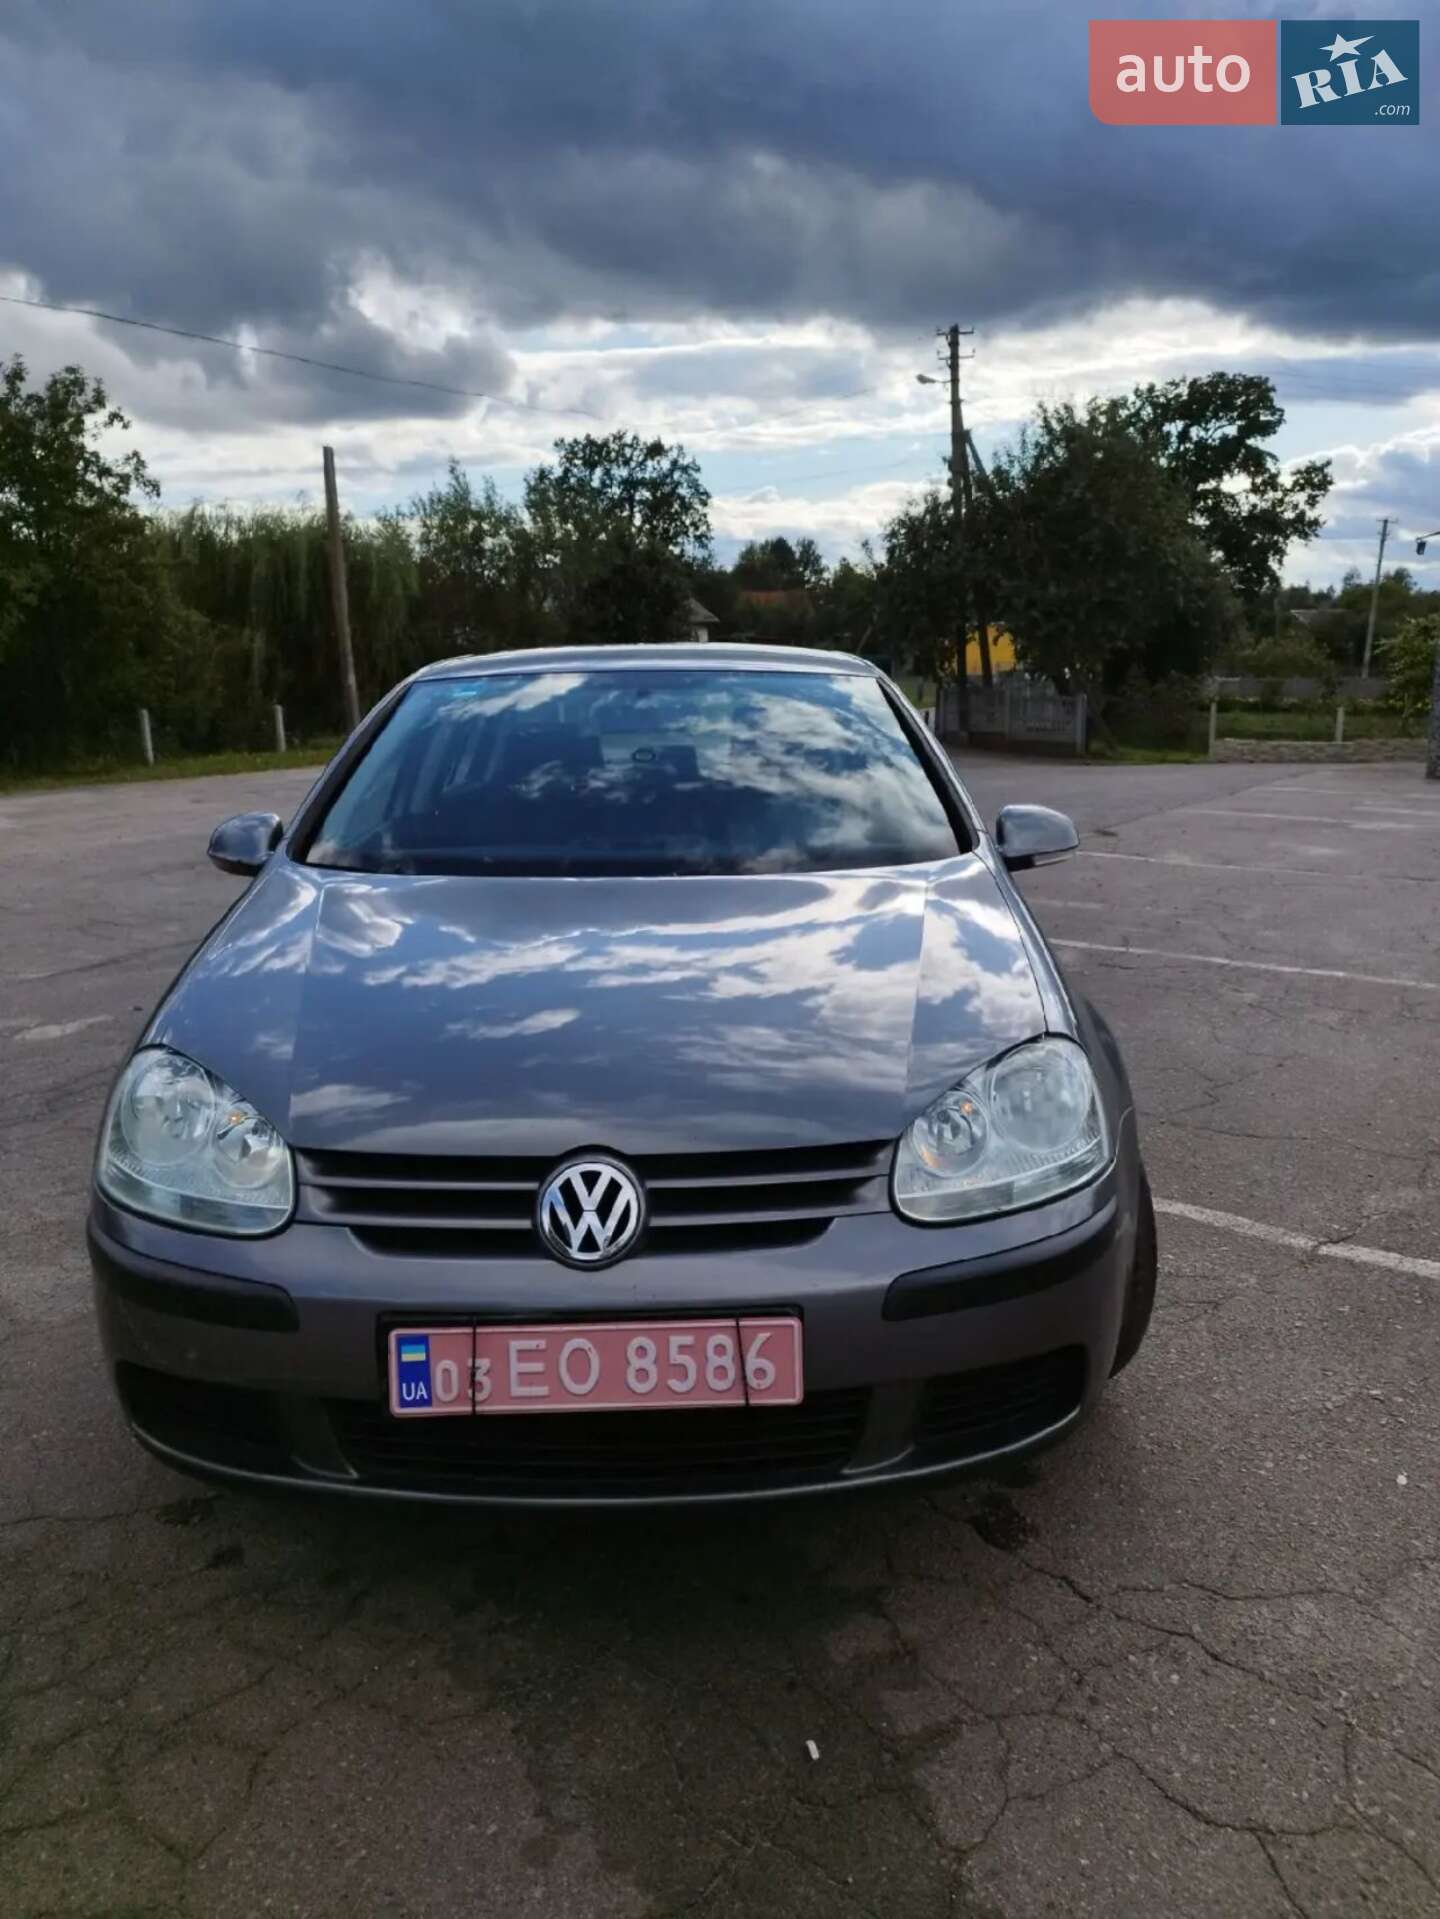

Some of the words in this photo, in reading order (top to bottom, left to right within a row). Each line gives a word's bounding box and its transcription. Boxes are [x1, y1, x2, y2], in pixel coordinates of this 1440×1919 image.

[434, 1357, 493, 1402] 03
[508, 1337, 601, 1398] EO
[625, 1332, 776, 1394] 8586
[402, 1380, 428, 1402] UA
